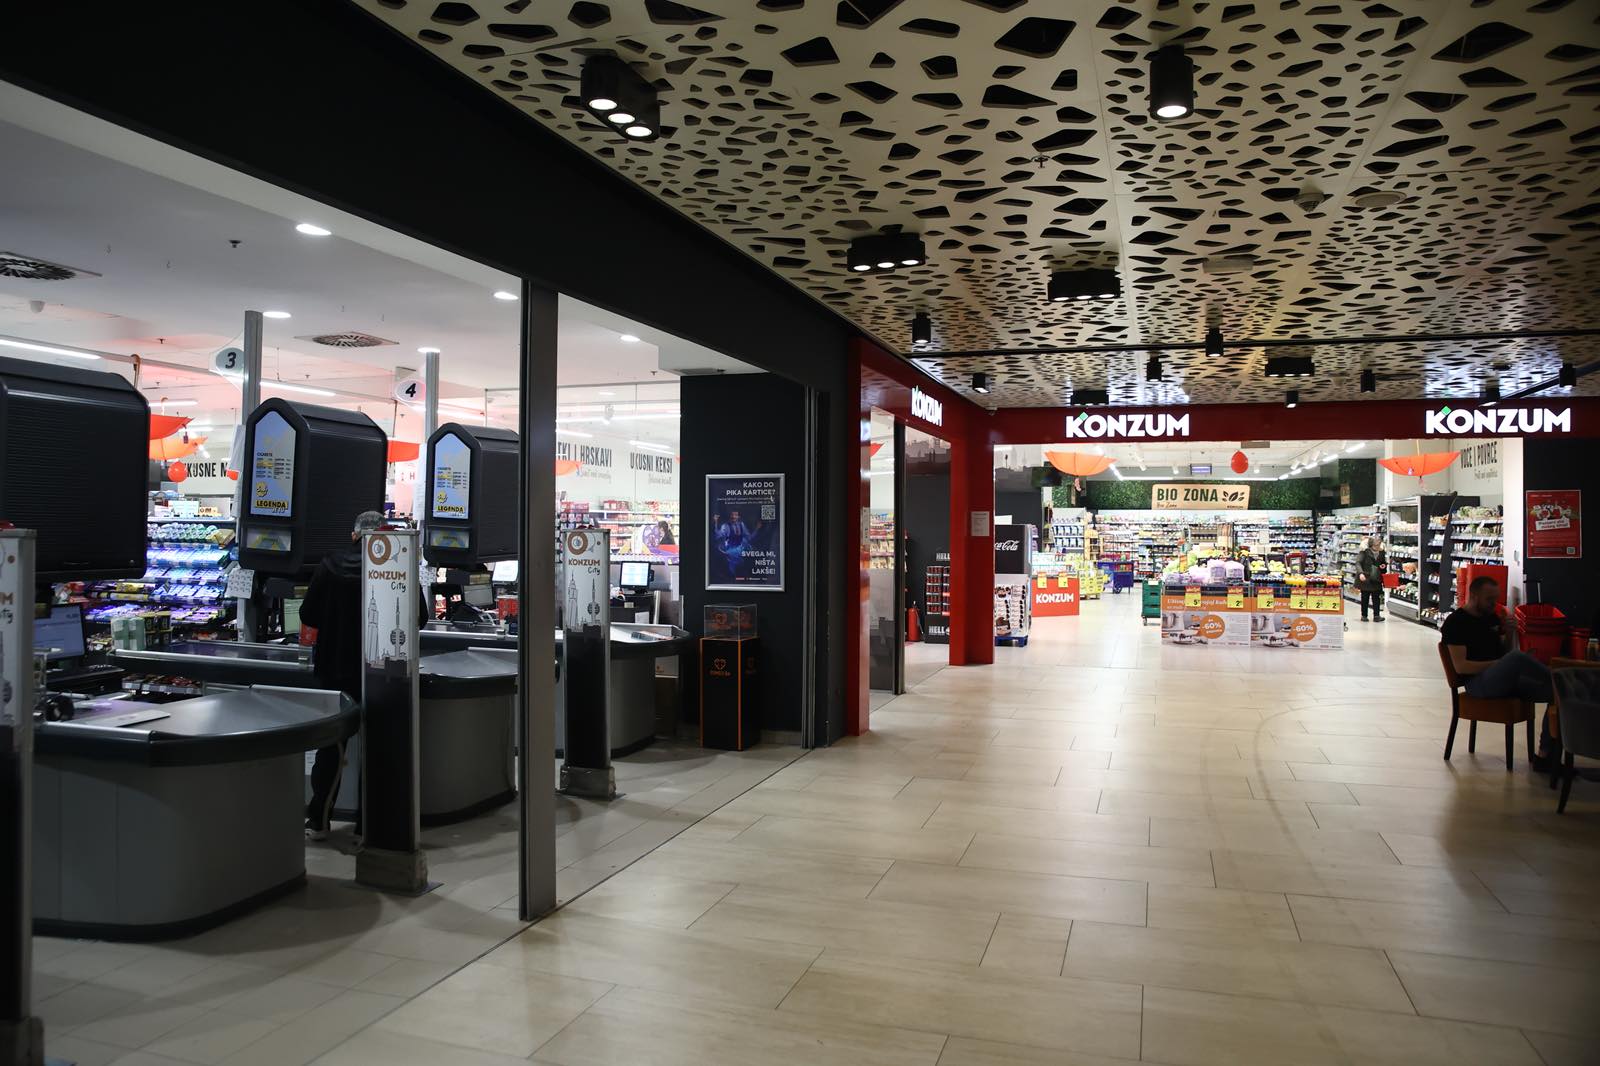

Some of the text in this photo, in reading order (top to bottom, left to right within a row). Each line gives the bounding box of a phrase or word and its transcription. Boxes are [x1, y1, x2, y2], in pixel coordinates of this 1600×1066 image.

[225, 351, 237, 369] 3
[405, 383, 416, 398] 4
[911, 385, 942, 427] KONZUM
[1066, 411, 1190, 438] KONZUM
[1425, 405, 1571, 434] KONZUM
[580, 445, 612, 468] HRSKAVI
[184, 462, 217, 478] KUSNE
[655, 455, 673, 474] KEKSI
[1157, 488, 1219, 502] BIO ZONA
[256, 500, 287, 508] LEGENDA
[437, 505, 465, 513] LEGENDA
[755, 558, 776, 566] NIŠTA
[936, 552, 950, 561] HELL
[368, 570, 407, 580] KONZUM
[588, 567, 601, 576] City
[390, 581, 407, 592] City
[1035, 592, 1075, 604] KONZUM
[928, 625, 946, 635] HELL
